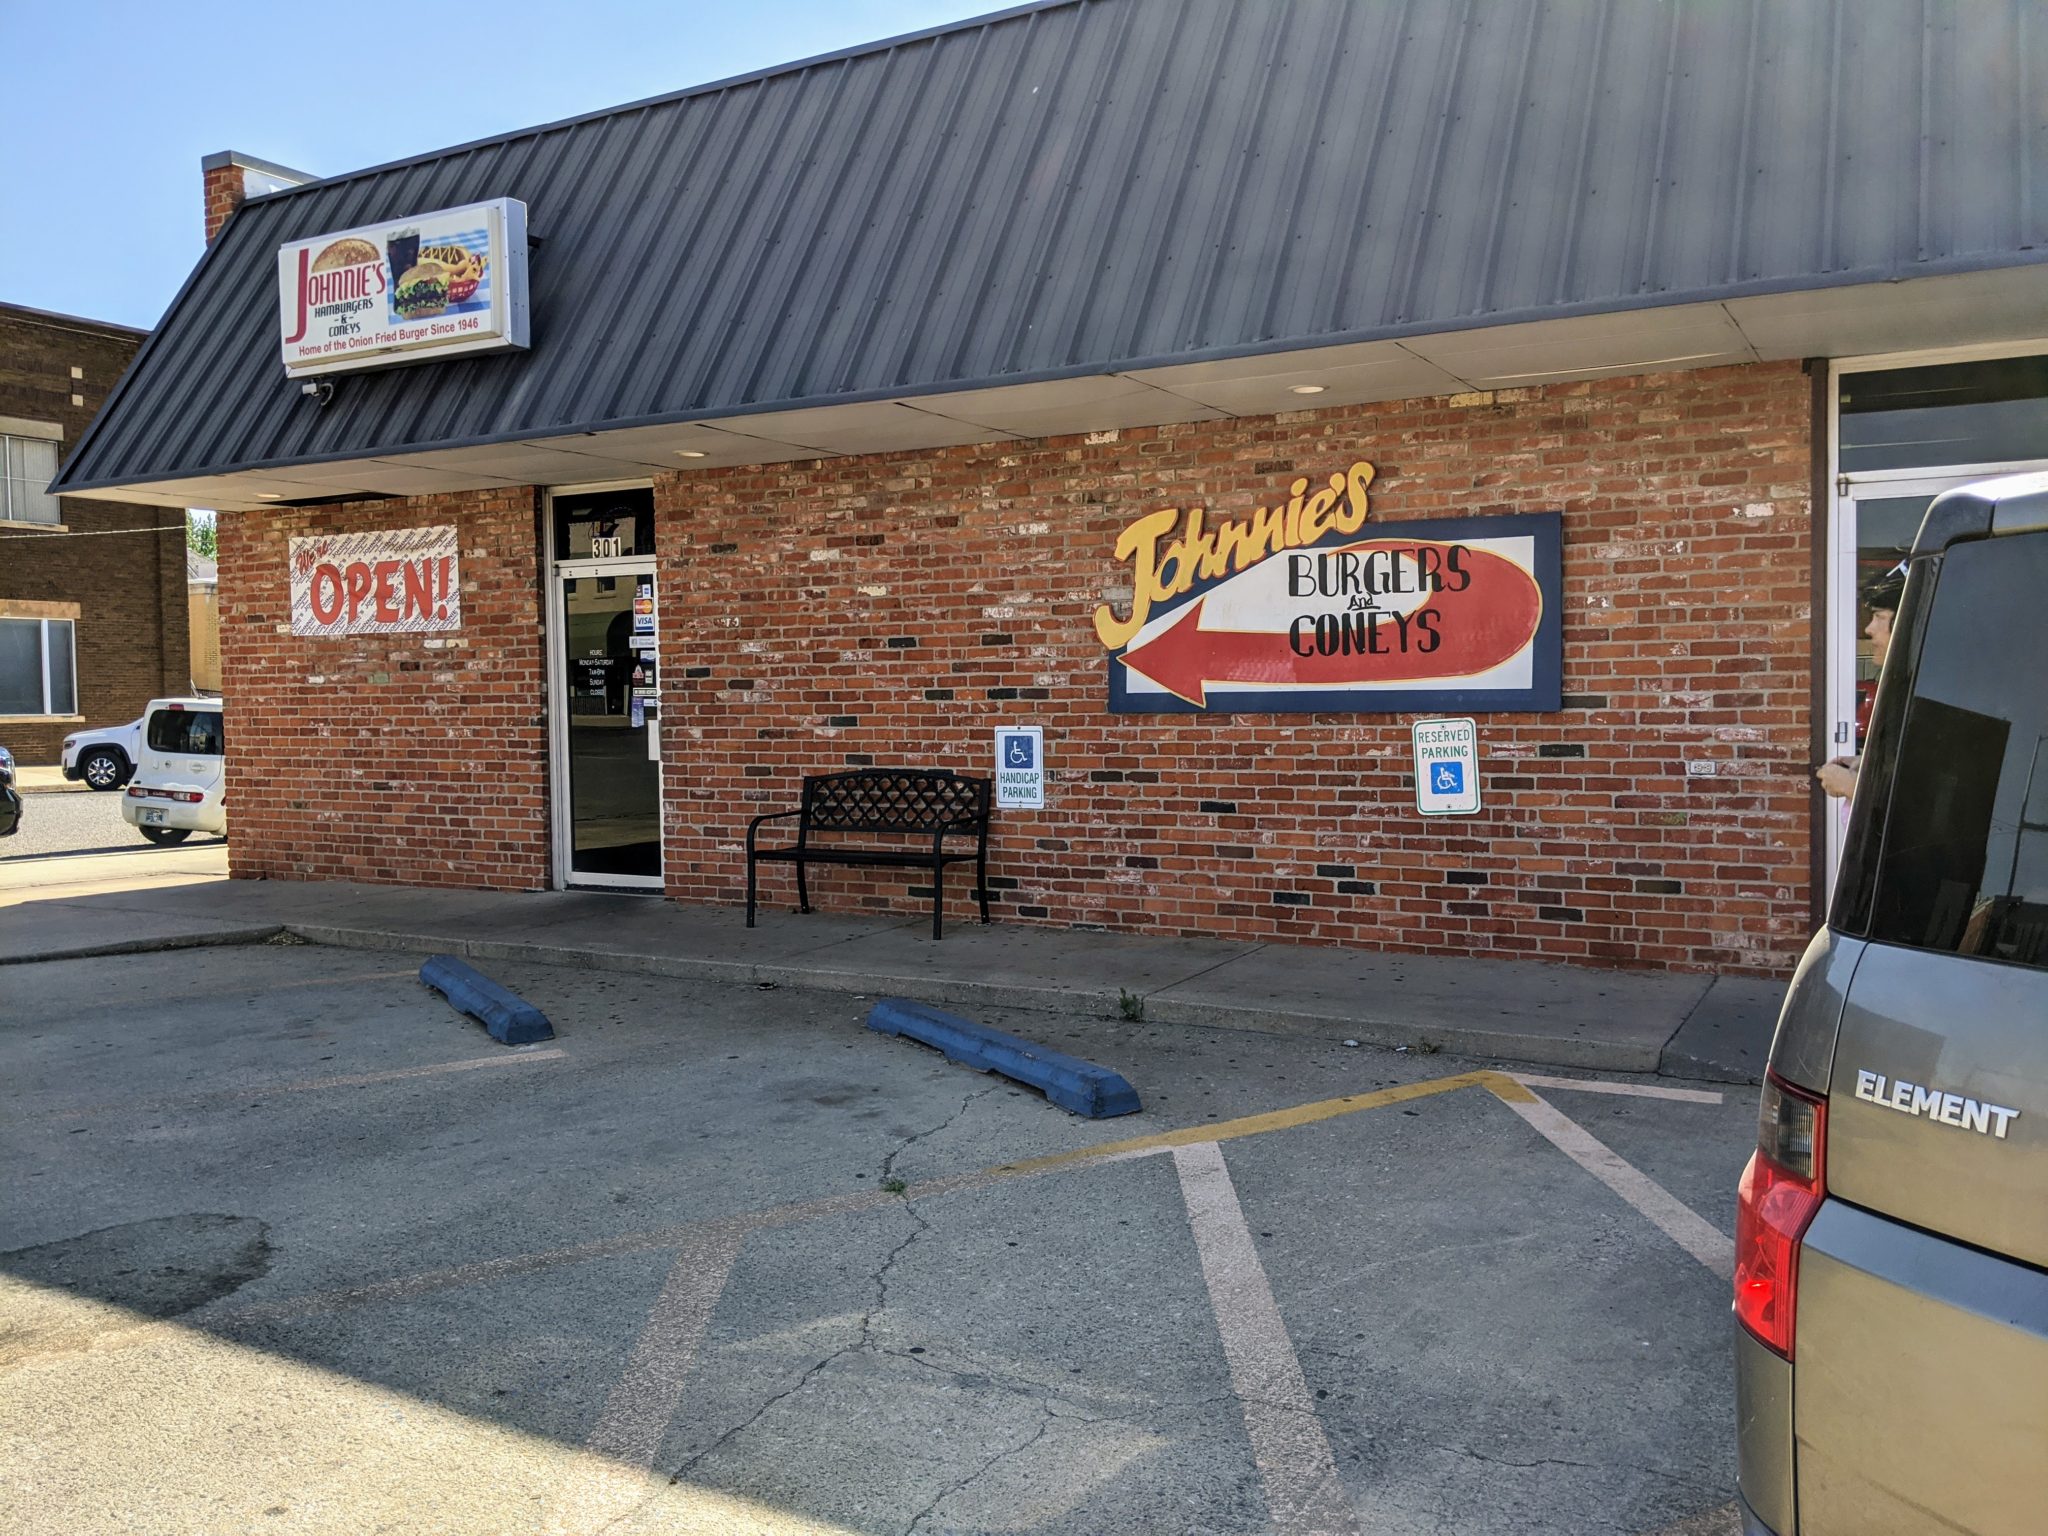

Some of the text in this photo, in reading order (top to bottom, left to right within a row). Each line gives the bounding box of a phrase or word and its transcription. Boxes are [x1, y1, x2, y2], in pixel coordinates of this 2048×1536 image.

[285, 248, 387, 344] JOHNNIE'S
[315, 298, 374, 318] HAMBURGERS
[299, 317, 479, 357] Home of the Onion Fried Burger Since 1946
[328, 322, 361, 338] CONEYS
[593, 538, 620, 558] 301
[1093, 461, 1376, 650] Johnnie's
[1288, 544, 1471, 598] BURGERS
[310, 555, 450, 625] OPEN!
[1347, 591, 1376, 610] And
[637, 617, 653, 625] VISA
[1289, 608, 1441, 657] CONEYS
[1419, 729, 1470, 743] RESERVED
[1422, 745, 1468, 759] PARKING
[1000, 772, 1040, 785] HANDICAP
[1003, 786, 1038, 799] PARKING
[1855, 1069, 2020, 1139] ELEMENT
